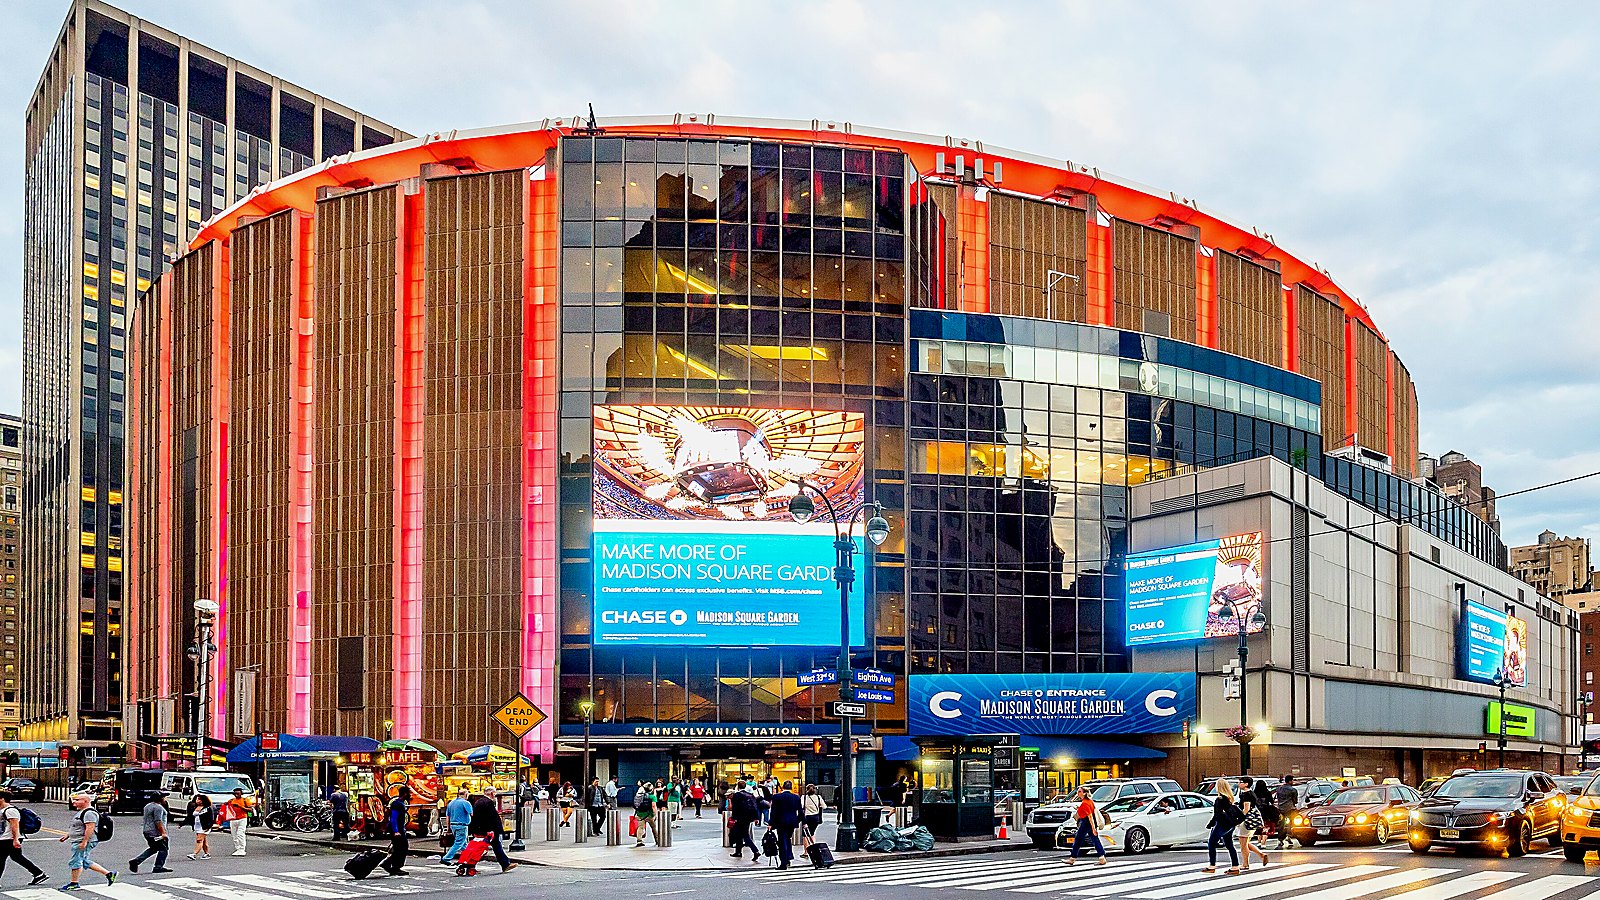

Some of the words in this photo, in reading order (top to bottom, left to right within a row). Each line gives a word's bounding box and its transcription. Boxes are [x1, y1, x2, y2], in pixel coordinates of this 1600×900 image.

[602, 544, 654, 560] MAKE
[660, 544, 715, 560] MORE
[720, 545, 746, 561] OF
[602, 564, 691, 579] MADISON
[697, 564, 772, 582] SQUARE
[778, 565, 837, 581] GARDE
[1130, 585, 1156, 594] MADISON
[1158, 582, 1182, 590] SQUARE
[1183, 578, 1208, 587] GARDEN
[1147, 577, 1164, 585] MORE
[602, 610, 667, 623] CHASE
[696, 610, 733, 622] MADISON
[735, 610, 766, 623] SQUARE
[1130, 622, 1156, 631] CHASE
[800, 675, 815, 683] West
[857, 672, 878, 682] Eighth
[879, 675, 891, 683] Ave
[858, 691, 867, 699] Joe
[868, 692, 882, 700] Louis
[930, 691, 962, 718] C
[981, 700, 1030, 715] MADISON
[1035, 699, 1077, 715] SQUARE
[1145, 689, 1177, 716] C
[635, 727, 739, 735] PENNSYLVANIA
[745, 727, 799, 735] STATION
